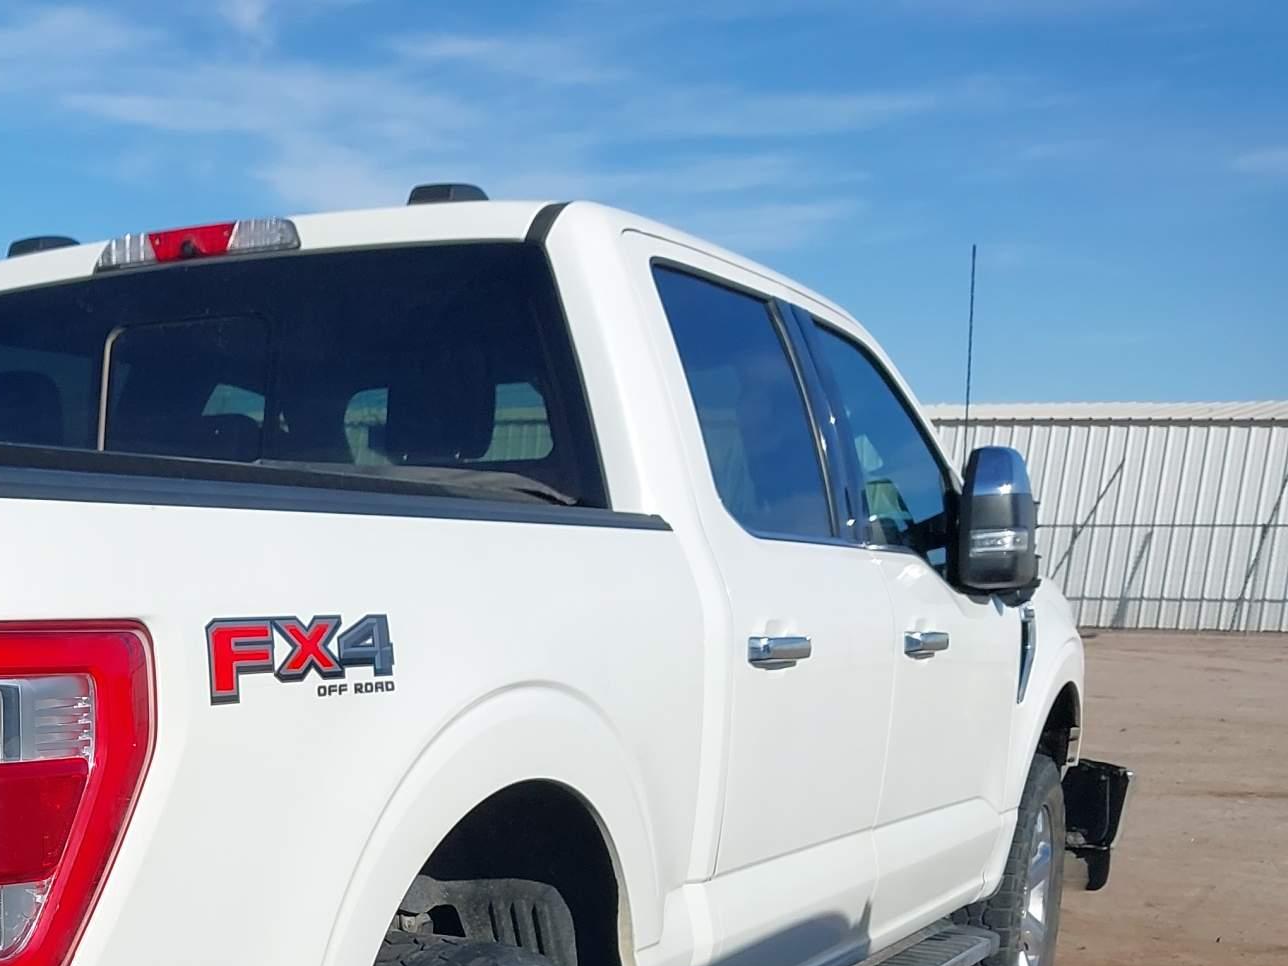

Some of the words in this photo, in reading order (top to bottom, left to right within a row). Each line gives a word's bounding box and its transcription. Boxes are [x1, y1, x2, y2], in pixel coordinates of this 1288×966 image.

[205, 614, 394, 706] FX4
[317, 683, 348, 697] OFF
[354, 681, 395, 695] ROAD
